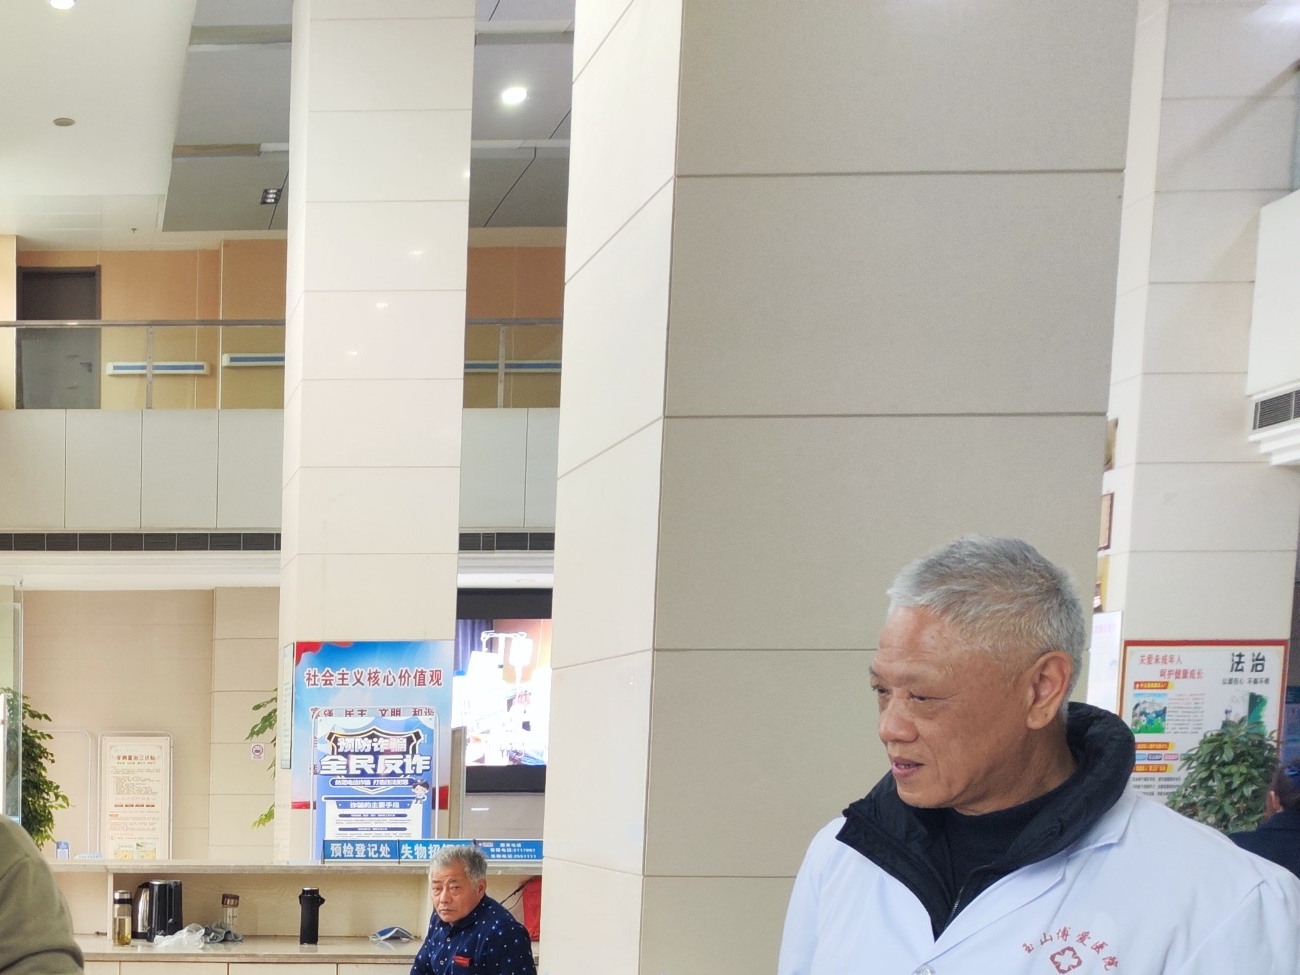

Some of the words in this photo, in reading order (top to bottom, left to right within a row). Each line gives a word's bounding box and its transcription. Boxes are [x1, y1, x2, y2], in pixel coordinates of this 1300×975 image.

[1230, 652, 1266, 673] 法治
[305, 669, 443, 687] 社会主义核心价值观
[337, 738, 407, 753] 预防诈骗
[319, 754, 432, 776] 全民反诈
[330, 843, 391, 858] 预检登记处
